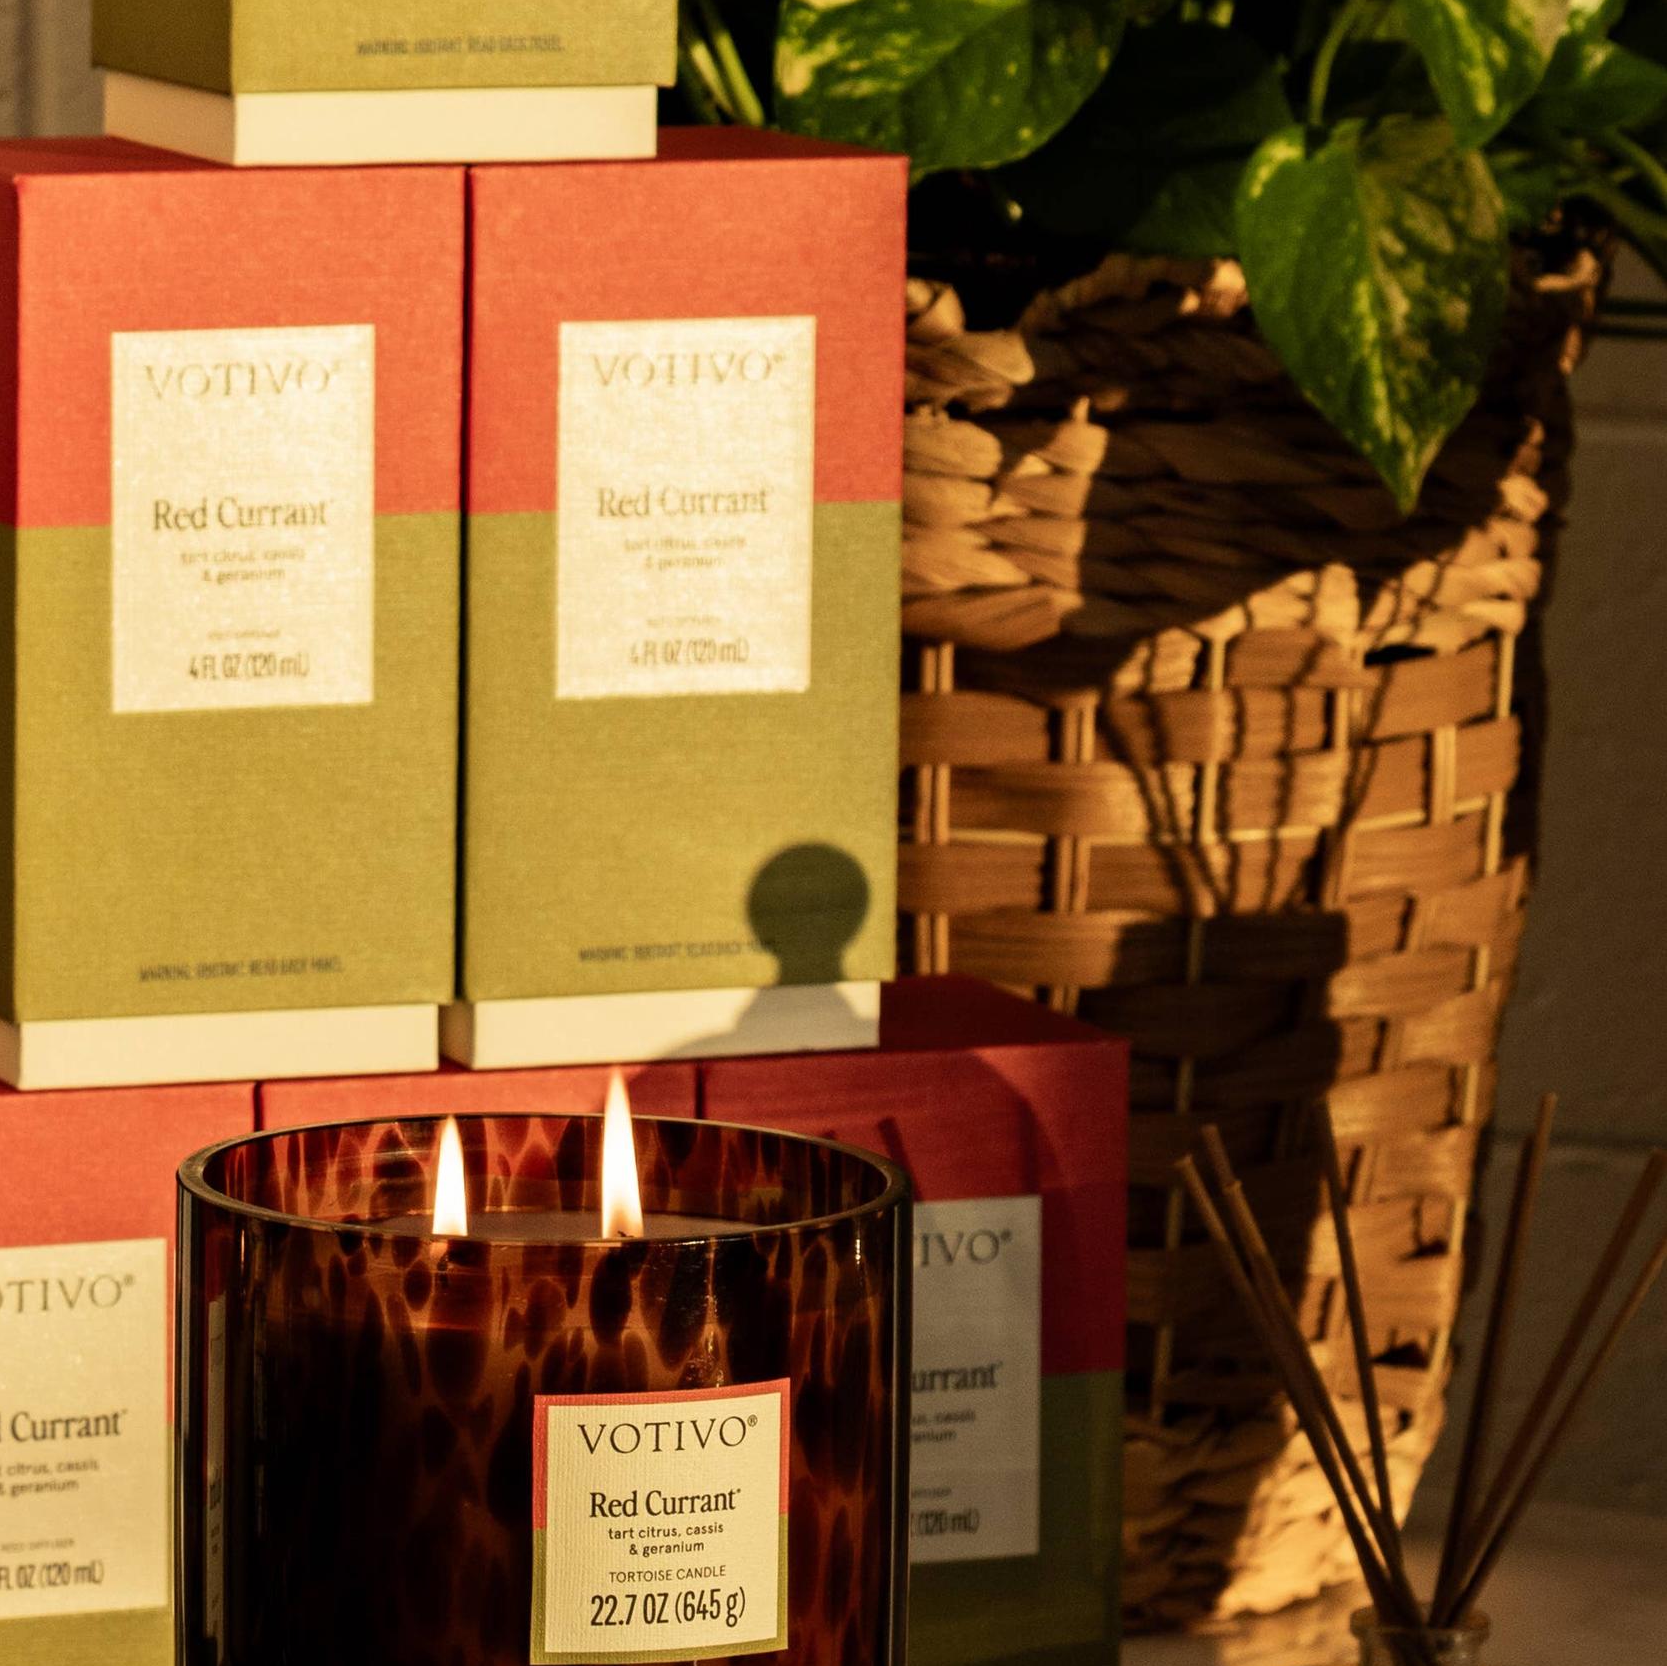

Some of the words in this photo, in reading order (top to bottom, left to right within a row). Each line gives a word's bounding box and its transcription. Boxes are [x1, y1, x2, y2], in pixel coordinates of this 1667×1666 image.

[154, 497, 207, 531] Red
[598, 486, 650, 518] Red
[911, 1362, 998, 1393] urrant
[11, 1409, 122, 1443] Currant
[10, 1479, 79, 1498] geranium
[589, 1490, 638, 1518] Red
[645, 1489, 736, 1516] Currant
[608, 1526, 634, 1540] tart
[638, 1524, 681, 1539] citrus,
[685, 1522, 724, 1536] cassis
[629, 1544, 638, 1556] &
[642, 1541, 705, 1558] geranium
[16, 1564, 36, 1589] OZ
[40, 1562, 71, 1588] (120
[609, 1568, 673, 1583] TORTOISE
[676, 1565, 727, 1580] CANDLE
[590, 1594, 637, 1626] 22.7
[643, 1592, 669, 1624] OZ
[675, 1589, 721, 1624] (645
[726, 1586, 746, 1628] g)
